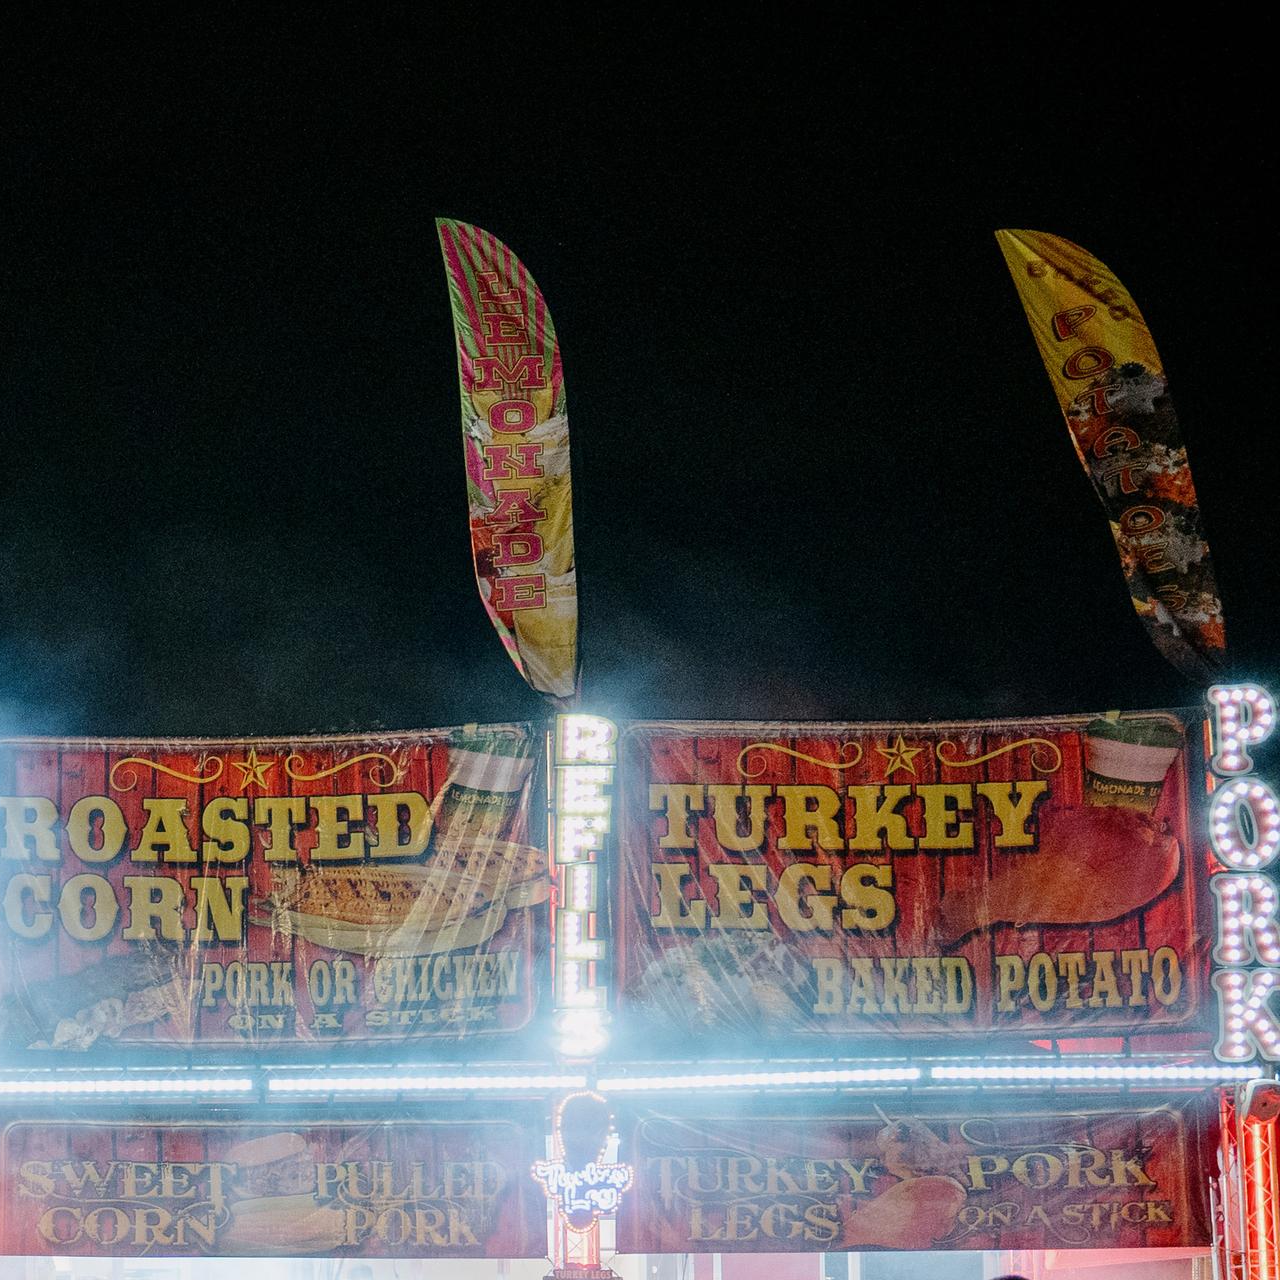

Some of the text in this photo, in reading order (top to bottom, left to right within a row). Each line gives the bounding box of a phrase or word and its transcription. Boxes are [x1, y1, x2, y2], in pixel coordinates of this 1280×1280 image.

[472, 271, 546, 612] LEMONADE
[1052, 304, 1188, 610] POTATOES
[648, 779, 1049, 852] TURKEY
[555, 712, 618, 1058] REFILLS
[650, 862, 896, 932] LEGS
[1207, 683, 1280, 1064] PORK
[2, 873, 250, 942] CORN
[202, 951, 520, 1008] PORK OR CHICKEN
[813, 947, 1183, 1015] BAKED POTATO
[313, 1012, 343, 1029] A
[16, 1159, 240, 1208] SWEET
[312, 1159, 508, 1202] PULLED
[646, 1152, 881, 1200] TURKEY
[966, 1147, 1158, 1193] PORK
[37, 1205, 220, 1247] CORN
[340, 1204, 483, 1246] PORK
[687, 1201, 843, 1242] LEGS
[1023, 1203, 1054, 1226] A
[1060, 1199, 1174, 1230] STICK
